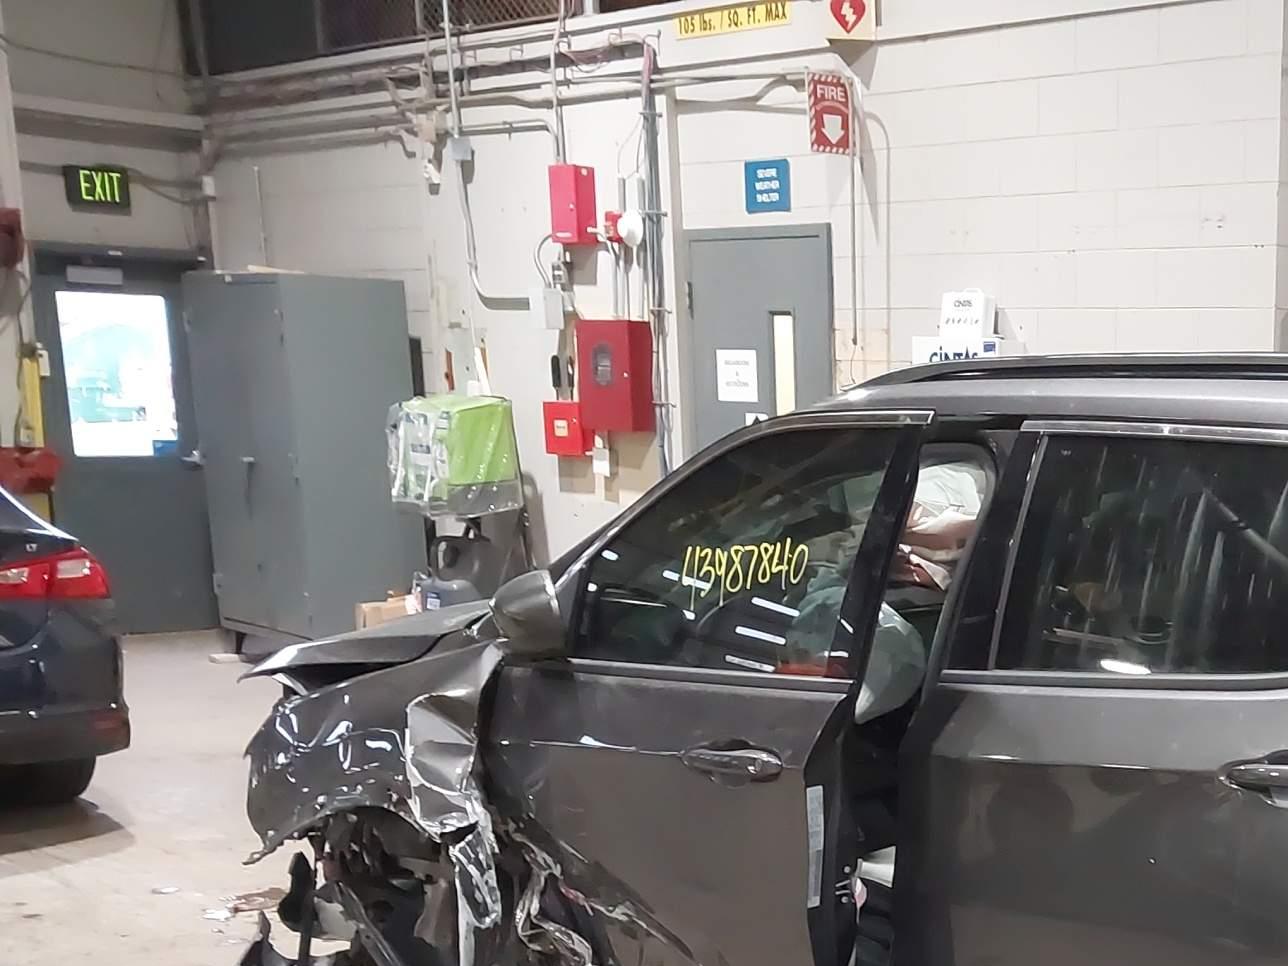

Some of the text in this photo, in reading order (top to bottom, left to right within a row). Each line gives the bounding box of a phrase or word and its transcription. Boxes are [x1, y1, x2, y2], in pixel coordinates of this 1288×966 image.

[678, 17, 695, 34] 105
[699, 13, 716, 32] lbs.
[728, 9, 743, 28] SQ.
[747, 6, 761, 25] FT.
[765, 2, 787, 22] MAX
[816, 84, 847, 102] FIRE
[79, 169, 121, 203] EXIT
[681, 537, 809, 611] 43987840
